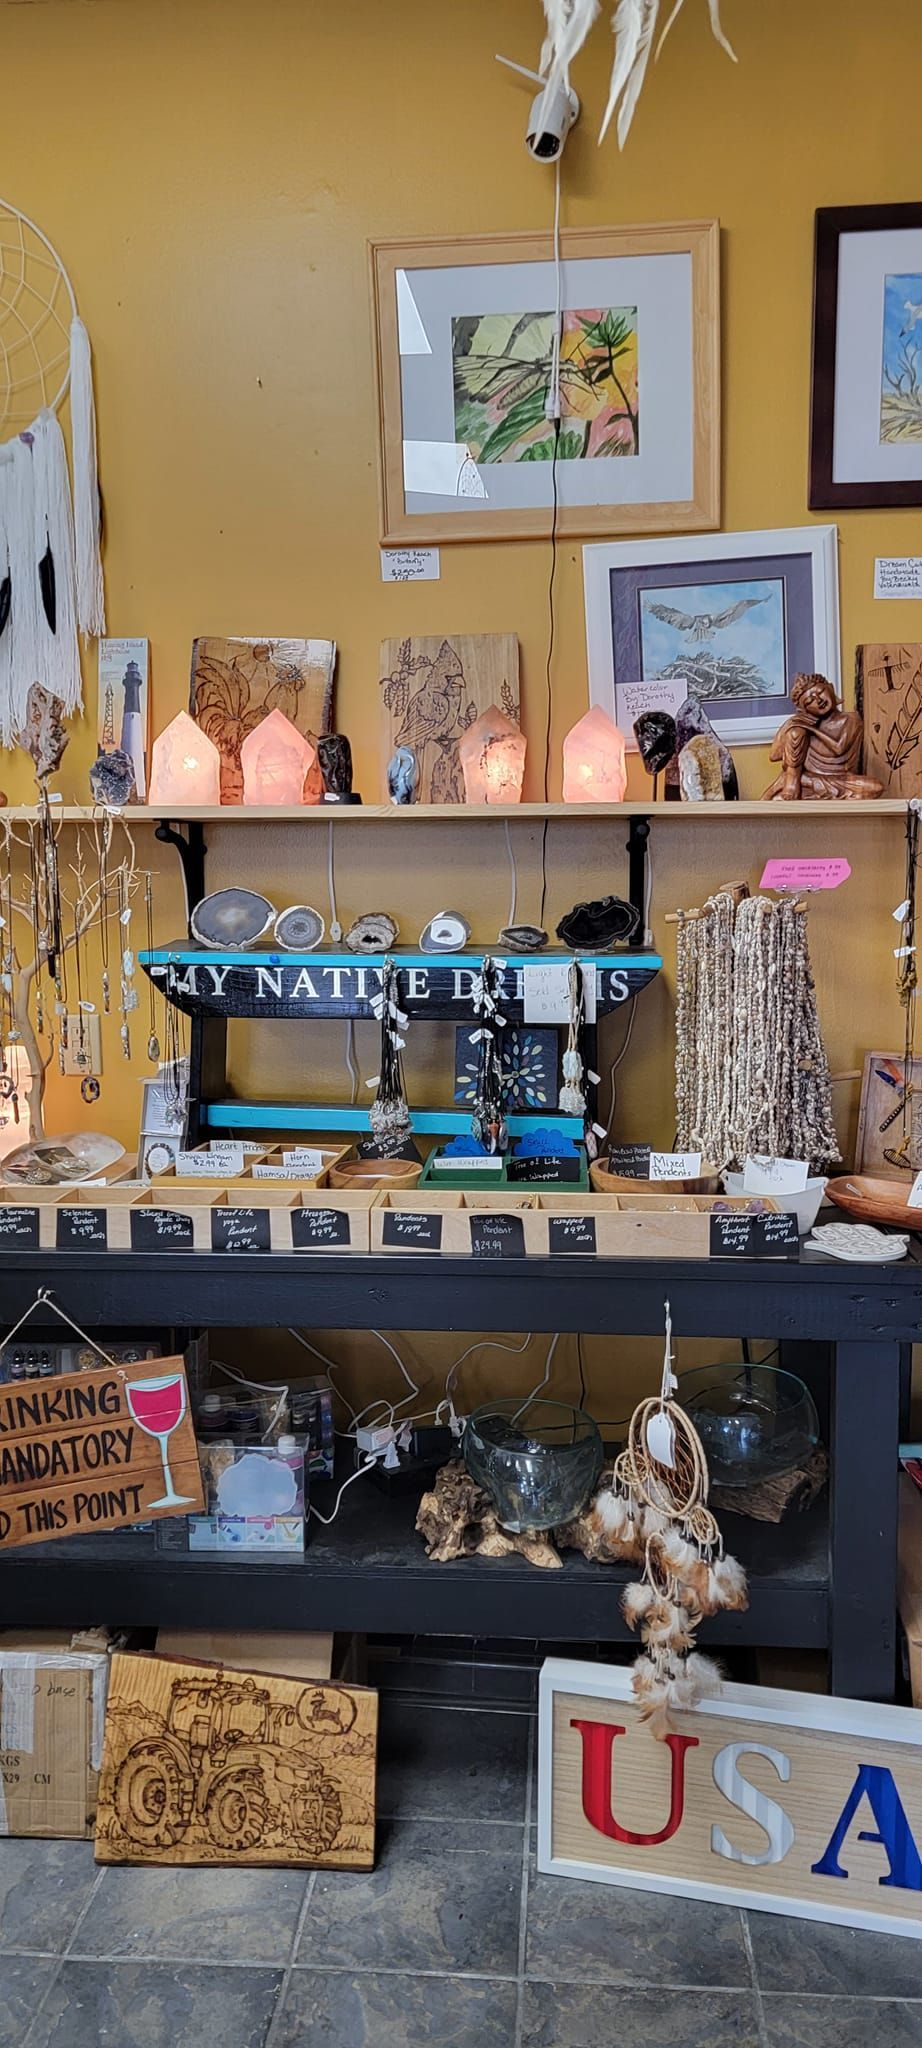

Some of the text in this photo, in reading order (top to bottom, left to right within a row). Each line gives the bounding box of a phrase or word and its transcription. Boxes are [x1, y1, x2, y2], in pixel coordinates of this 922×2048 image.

[640, 691, 675, 703] Dorothy
[214, 1141, 239, 1152] Heart
[289, 1153, 310, 1161] Horn
[653, 1155, 685, 1168] Mixed
[0, 1381, 121, 1432] INKING
[0, 1426, 134, 1485] ANDATORY
[17, 1499, 68, 1534] THIS
[73, 1483, 144, 1525] POINT
[34, 1773, 51, 1785] CM
[570, 1719, 922, 1891] USA
